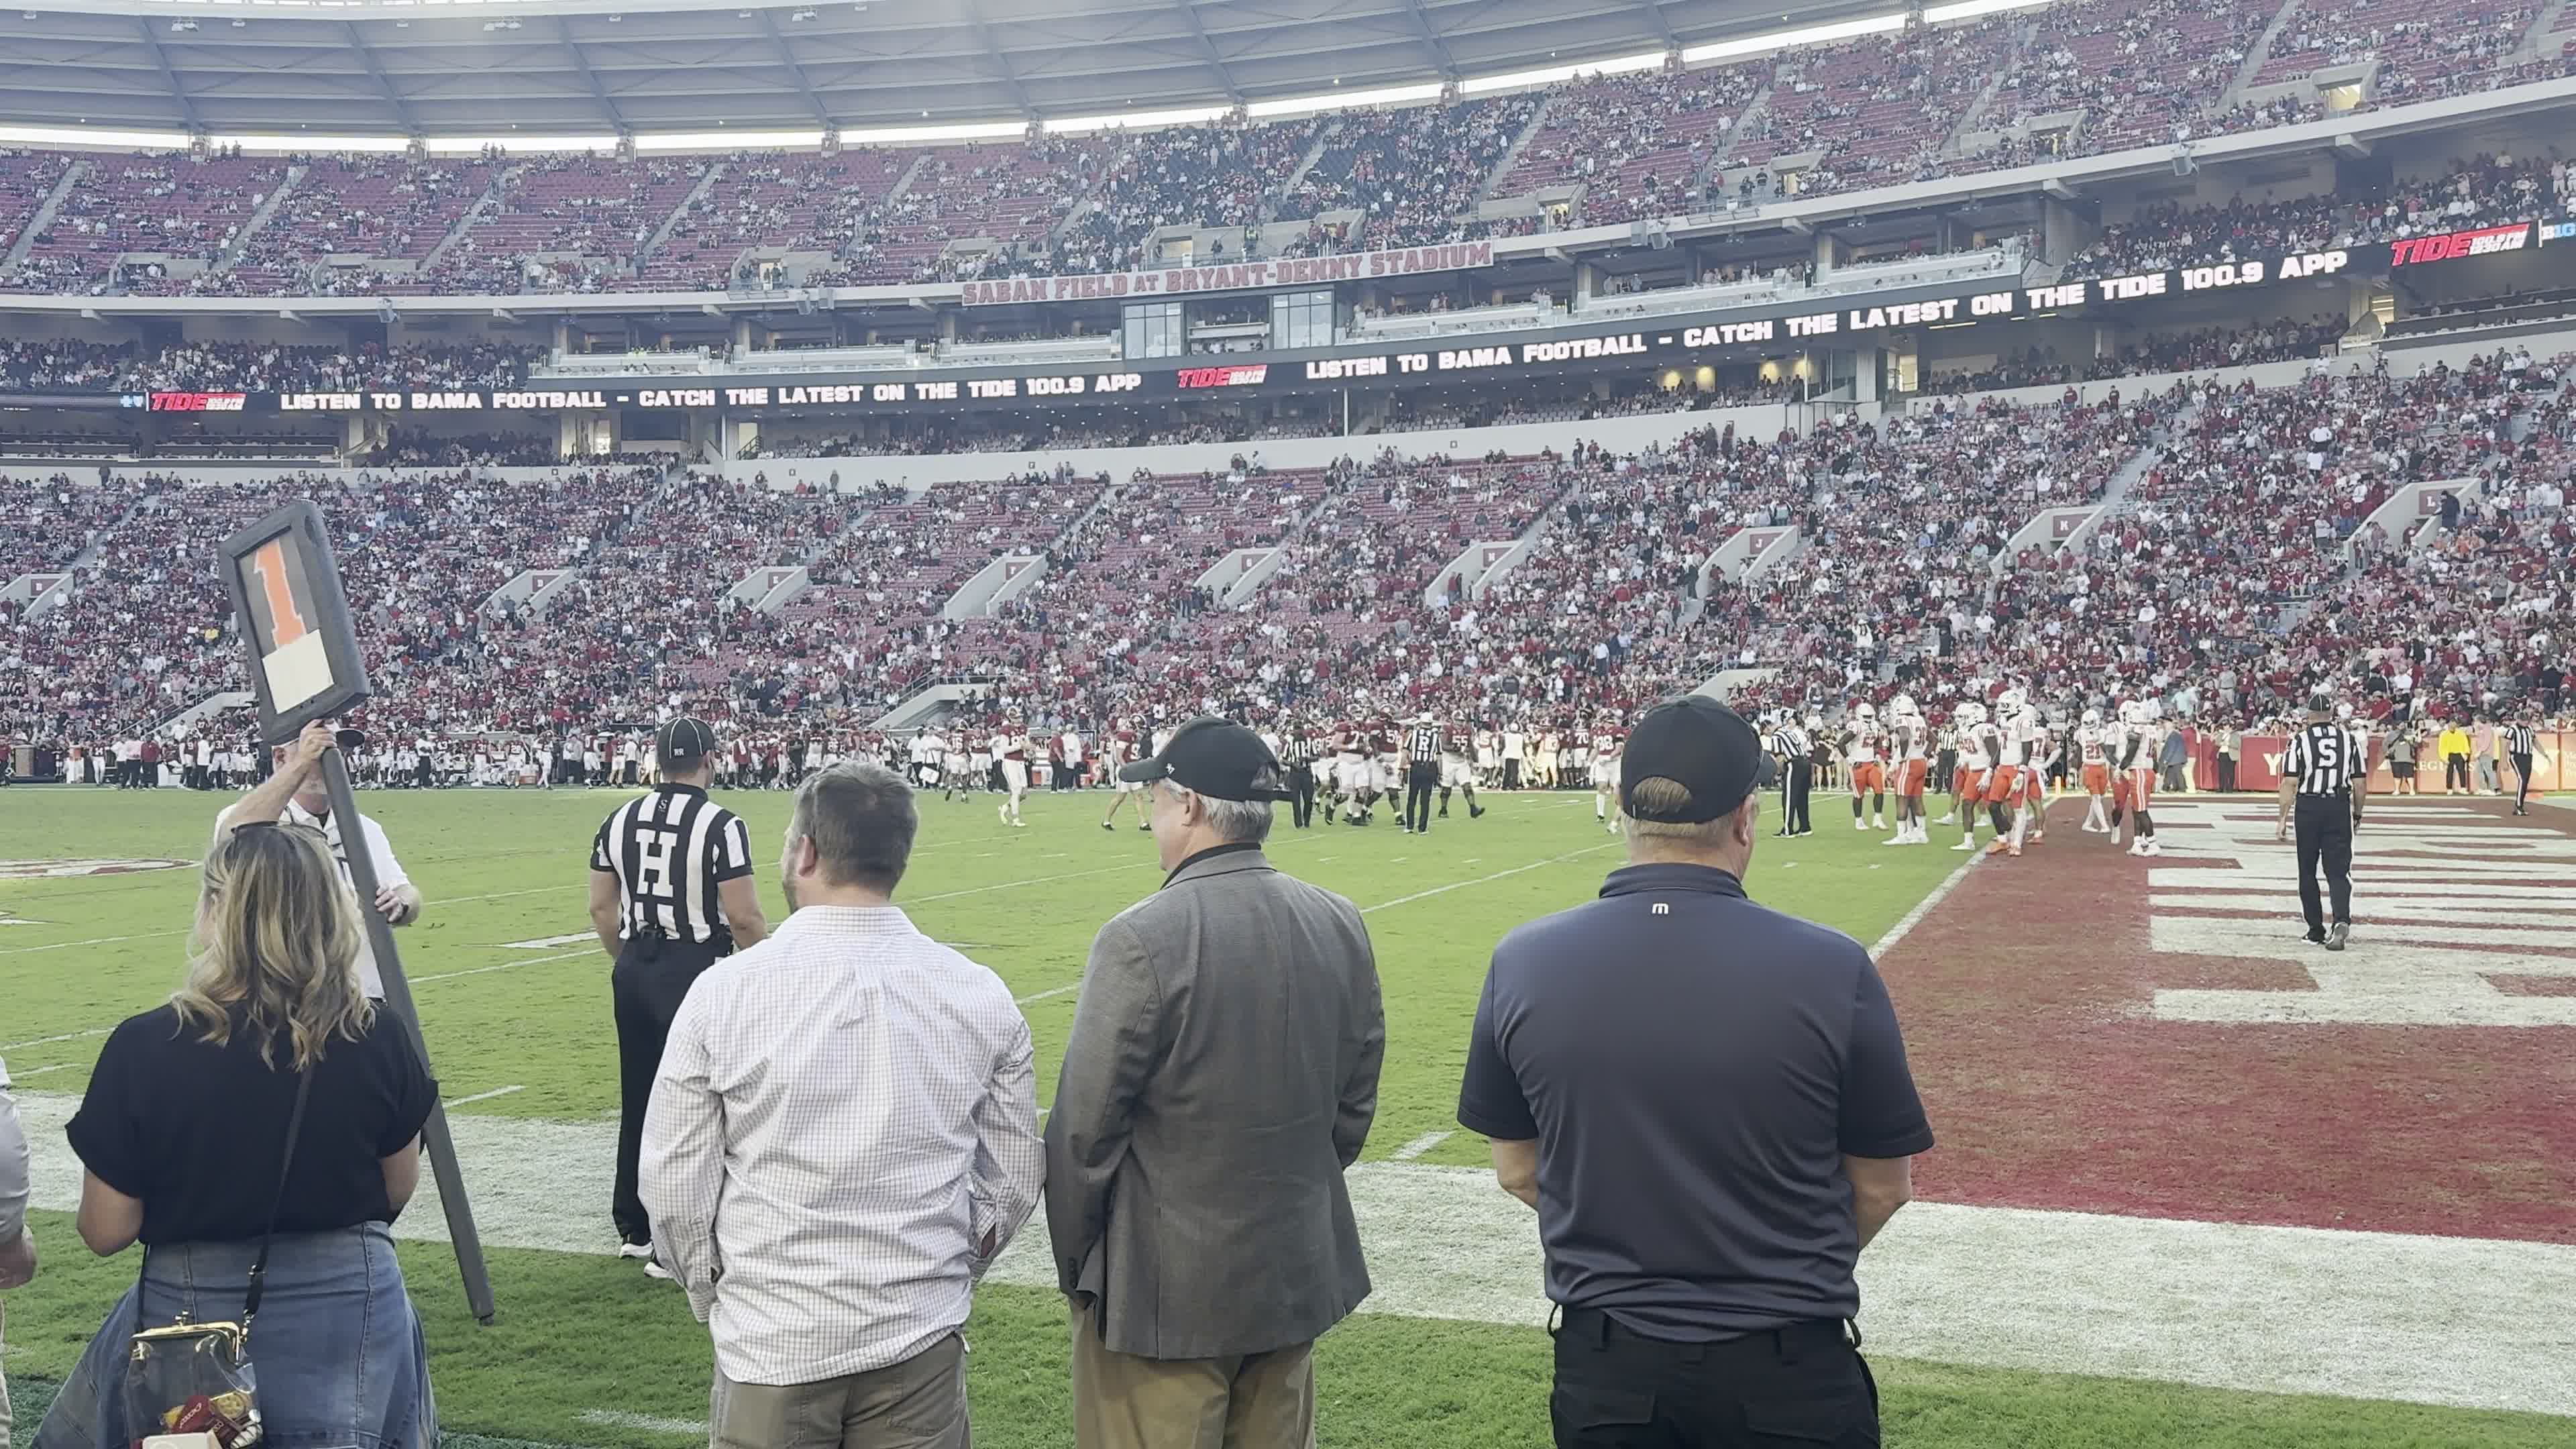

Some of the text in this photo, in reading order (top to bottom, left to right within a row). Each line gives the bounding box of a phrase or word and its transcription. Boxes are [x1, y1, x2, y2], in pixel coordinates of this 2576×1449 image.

[2391, 234, 2471, 266] TIDE
[963, 242, 1491, 304] SABAN FIELD AT BRYANT-DENNY STADIUM
[1306, 356, 1387, 379] LISTEN
[1397, 354, 1428, 373] TO
[1438, 346, 1513, 370] BAMA
[1523, 334, 1648, 363] FOOTBALL
[1684, 321, 1773, 347] CATCH
[1785, 313, 1837, 337] THE
[1850, 299, 1958, 330] LATEST
[1971, 292, 2012, 315] ON
[2027, 283, 2085, 309] THE
[2099, 274, 2166, 300] TIDE
[2181, 260, 2263, 290] 100.9
[2279, 252, 2347, 278] APP
[1177, 368, 1230, 388] TIDE
[151, 394, 209, 411] TIDE
[280, 393, 362, 410] LISTEN
[370, 393, 401, 409] TO
[411, 392, 482, 409] BAMA
[492, 391, 607, 409] FOOTBALL
[639, 389, 715, 407] CATCH
[725, 388, 768, 405] THE
[778, 385, 864, 404] LATEST
[873, 384, 905, 401] ON
[914, 382, 957, 400] THE
[967, 379, 1016, 398] TIDE
[1026, 376, 1085, 395] 100.9
[1094, 373, 1141, 392] APP
[2426, 496, 2436, 507] L
[2060, 520, 2069, 531] K
[1756, 539, 1762, 548] J
[253, 539, 307, 651] 1
[674, 748, 684, 756] RR
[1418, 736, 1430, 751] R
[2318, 737, 2337, 767] S
[635, 828, 678, 898] H
